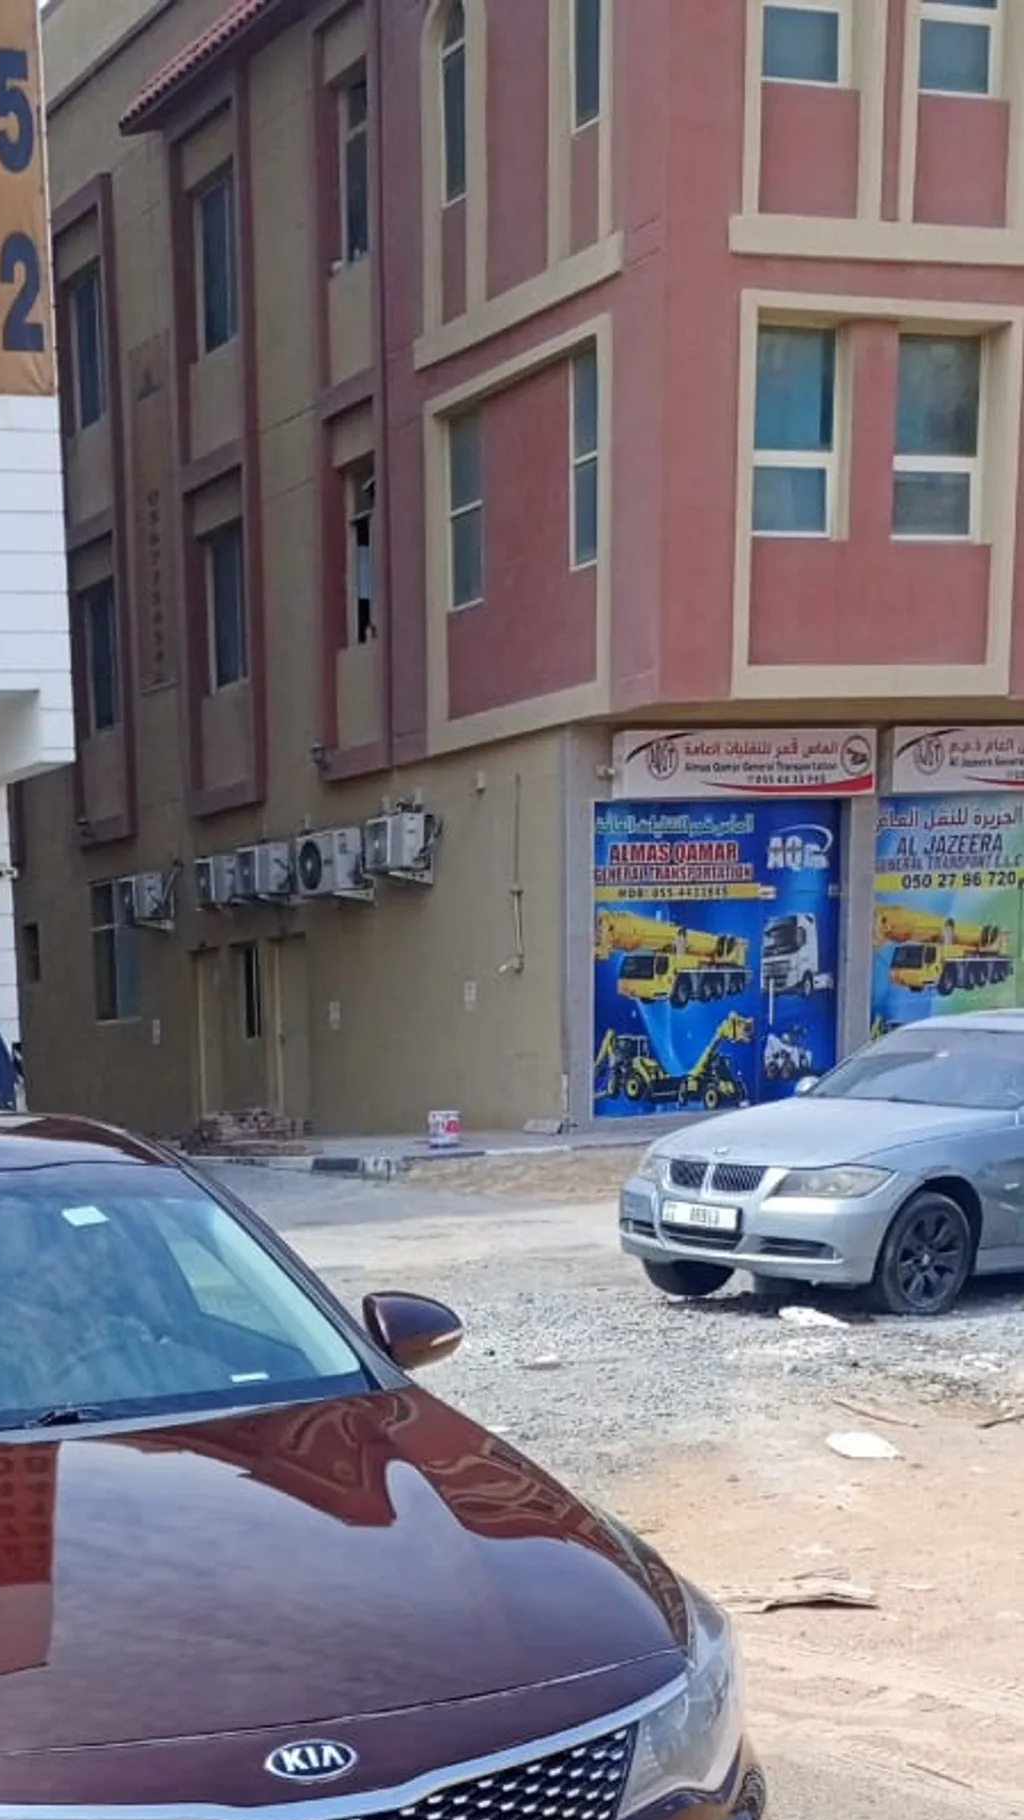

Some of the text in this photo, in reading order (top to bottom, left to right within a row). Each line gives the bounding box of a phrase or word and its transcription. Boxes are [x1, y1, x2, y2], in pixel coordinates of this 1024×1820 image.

[995, 756, 1024, 766] Genera
[610, 843, 738, 864] ALMAS QAMAR
[896, 833, 1003, 857] AL JAZEERA
[650, 865, 753, 882] TRANSPORTATION
[901, 871, 1016, 889] 050 27 96 720
[280, 1745, 345, 1772] KIA
